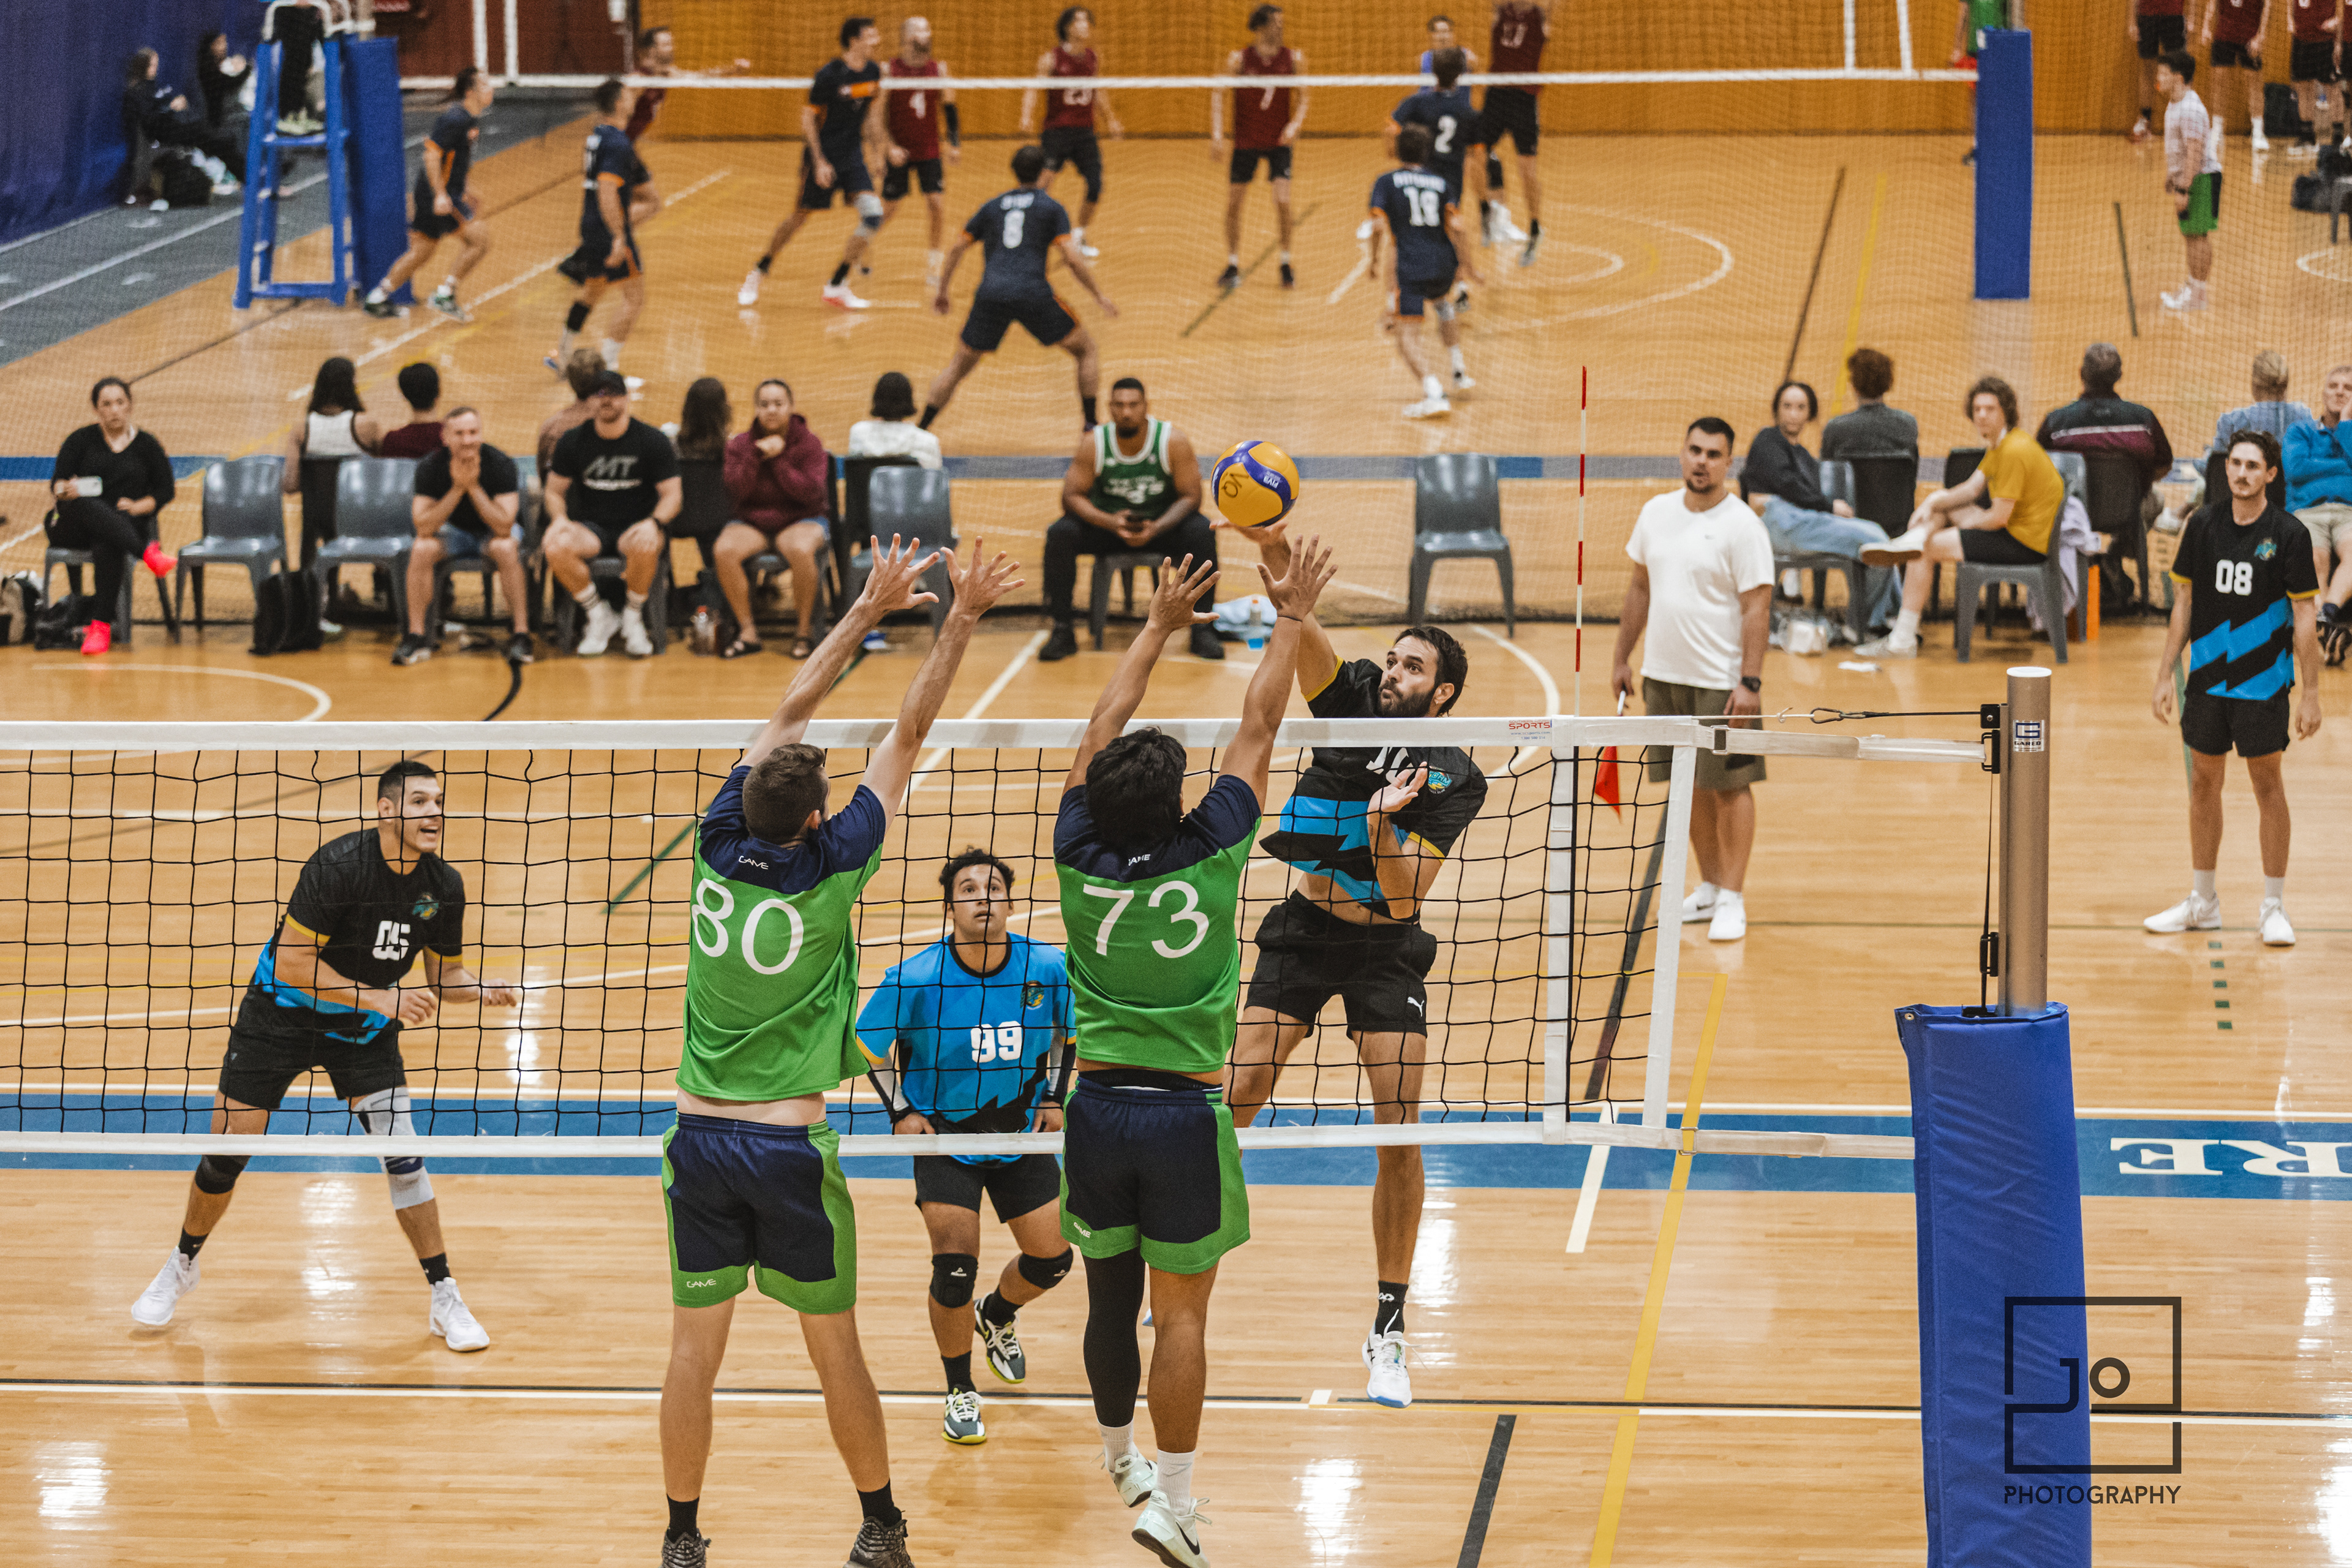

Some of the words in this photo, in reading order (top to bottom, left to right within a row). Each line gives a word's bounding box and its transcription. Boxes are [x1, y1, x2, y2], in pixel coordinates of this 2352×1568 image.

[1434, 115, 1457, 153] 2
[2215, 559, 2253, 596] 08
[739, 856, 769, 870] GAME
[692, 878, 804, 974] 80
[1083, 881, 1209, 958] 73
[372, 920, 410, 961] 05
[970, 1020, 1022, 1063] 99
[687, 1278, 717, 1288] GAME
